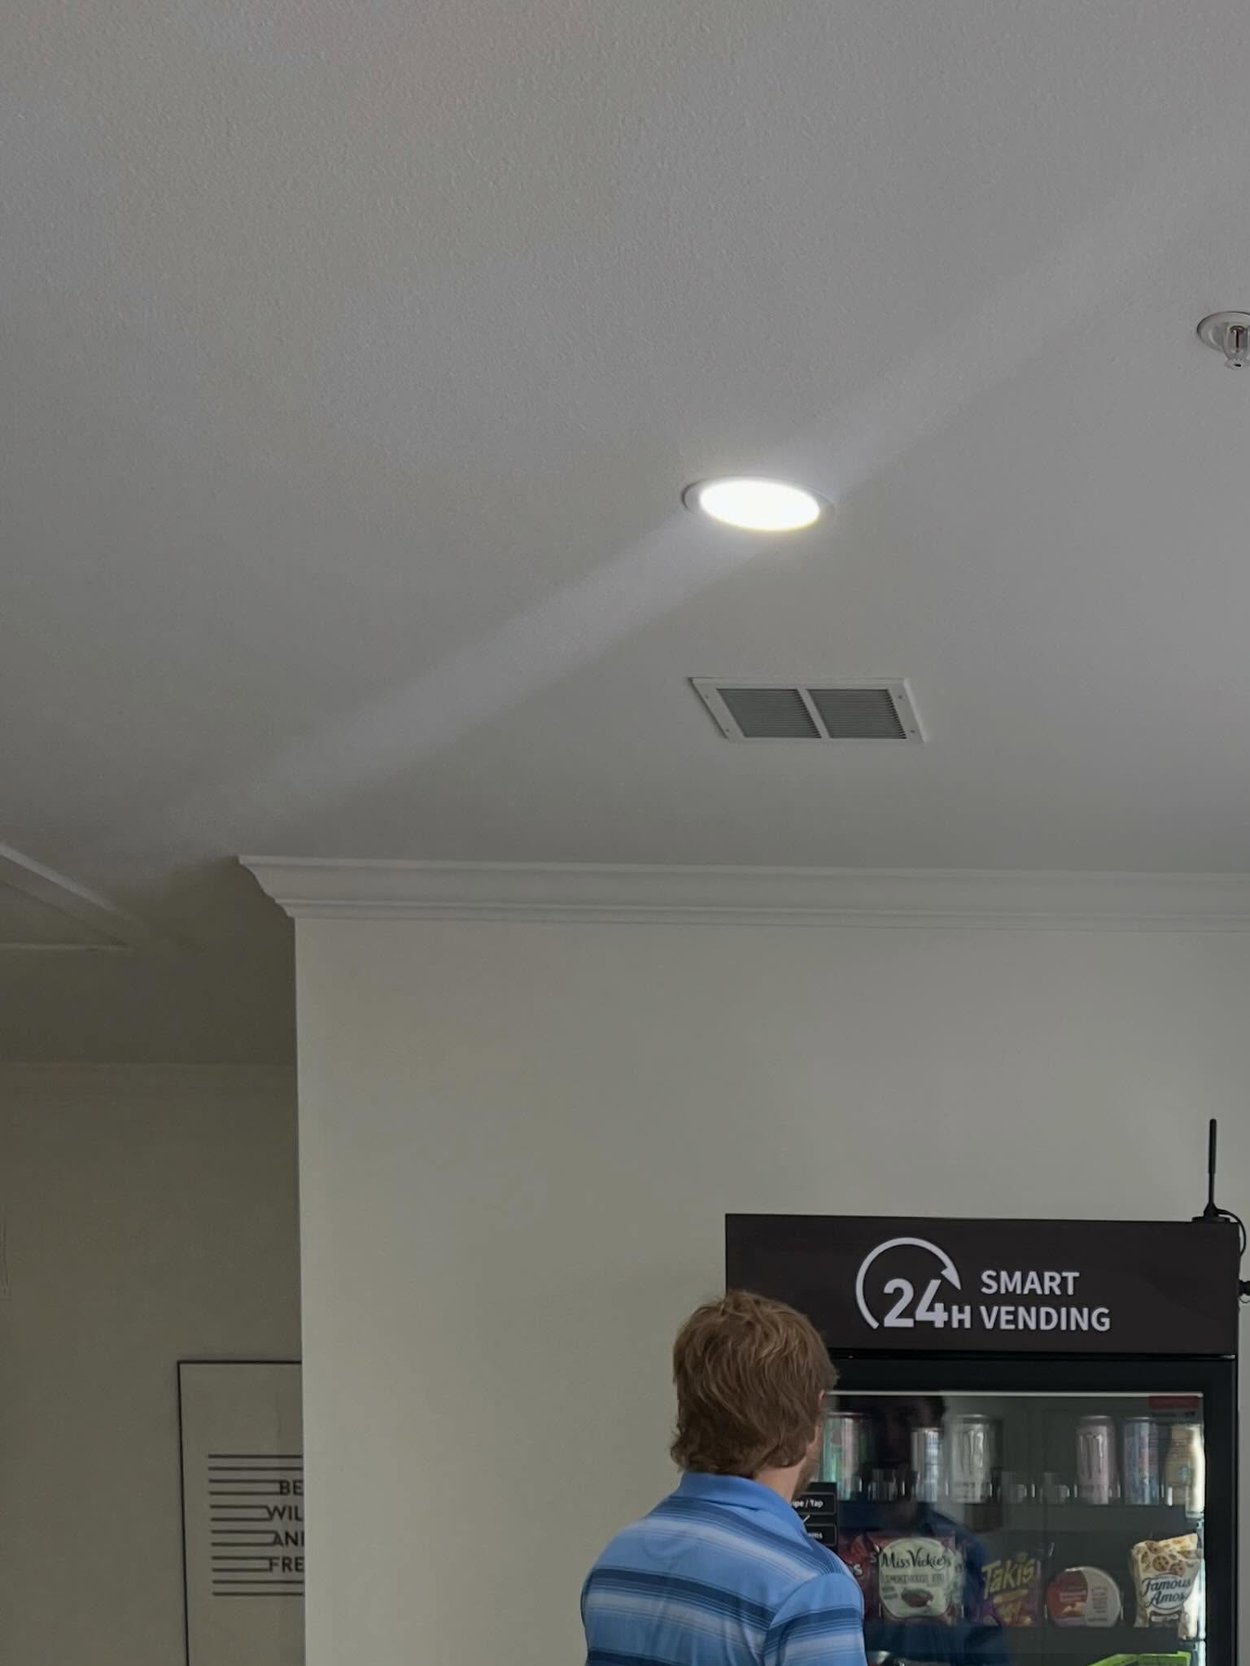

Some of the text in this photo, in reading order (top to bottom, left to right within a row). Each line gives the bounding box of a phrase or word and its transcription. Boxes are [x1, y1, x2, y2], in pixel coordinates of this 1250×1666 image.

[980, 1269, 1080, 1296] SMART
[980, 1305, 1111, 1332] VENDING
[272, 1531, 304, 1547] AN
[880, 1552, 910, 1569] Miss
[981, 1552, 1036, 1600] Takis
[1142, 1577, 1191, 1597] Famous
[1144, 1590, 1187, 1608] Amos
